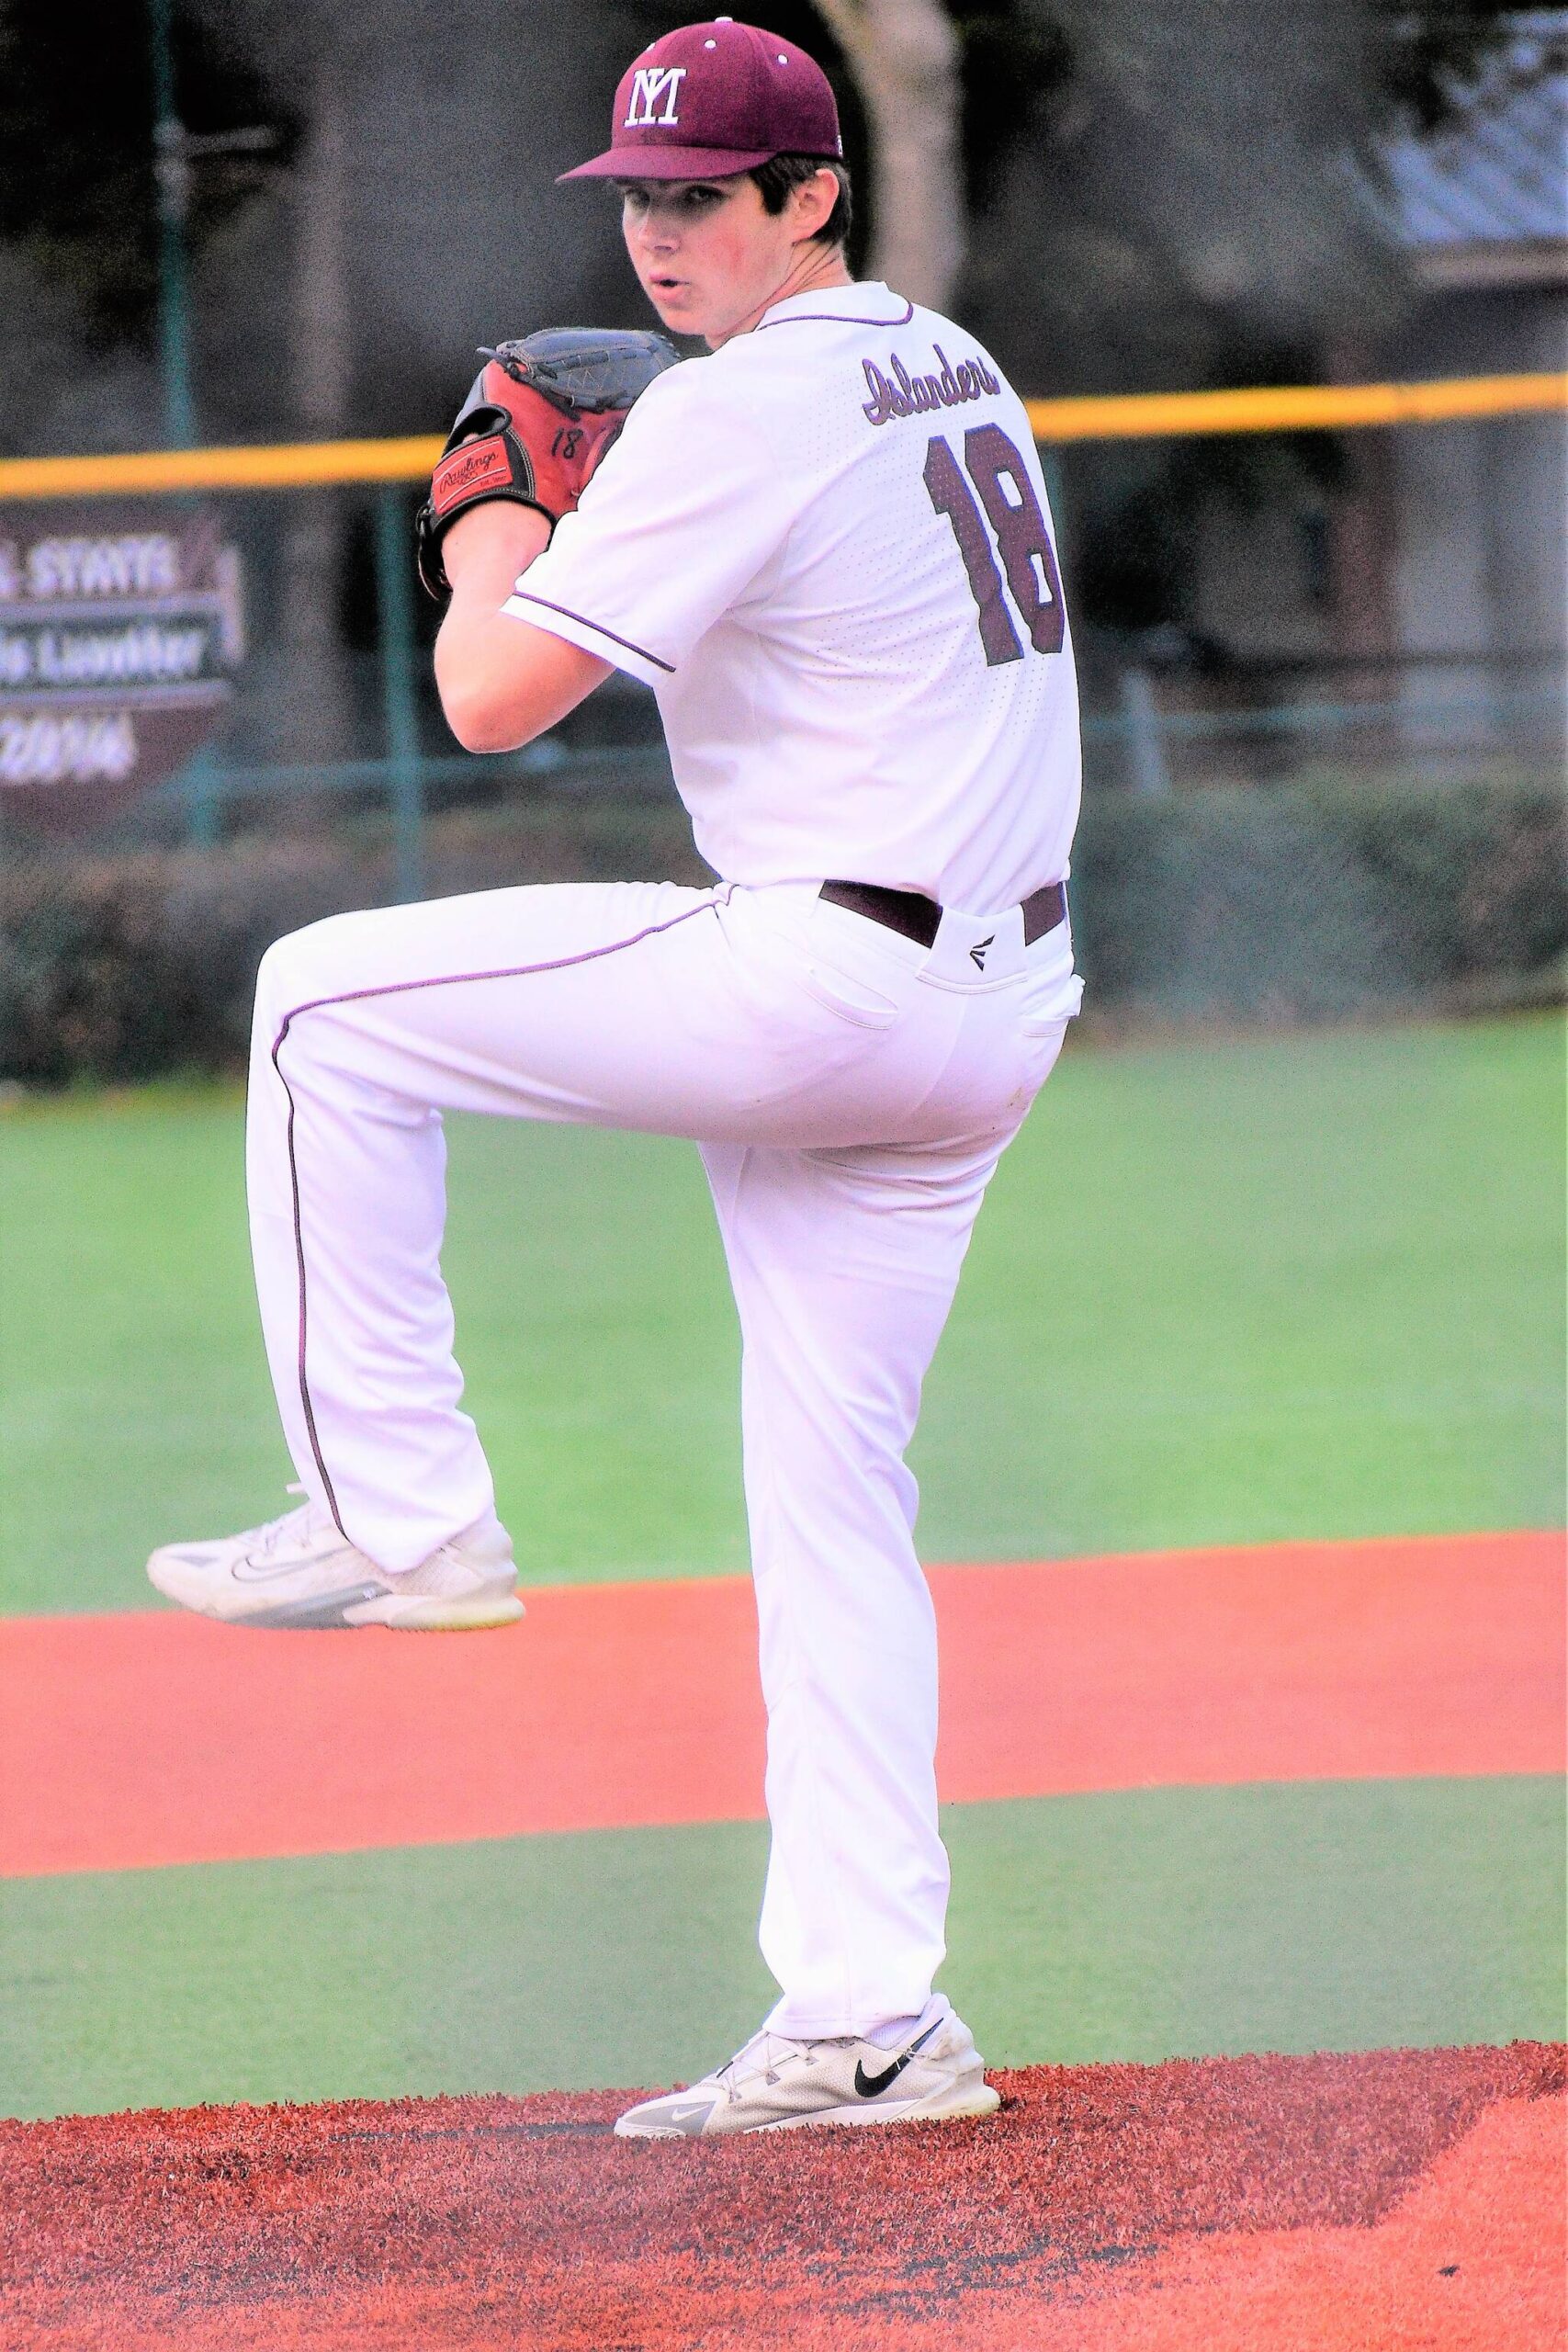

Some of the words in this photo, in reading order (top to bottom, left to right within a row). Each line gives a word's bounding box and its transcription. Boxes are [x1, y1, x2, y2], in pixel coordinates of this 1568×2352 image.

[862, 343, 1001, 425] Islanders
[439, 451, 498, 493] Rawlings
[551, 426, 584, 459] 18
[922, 422, 1065, 667] 18
